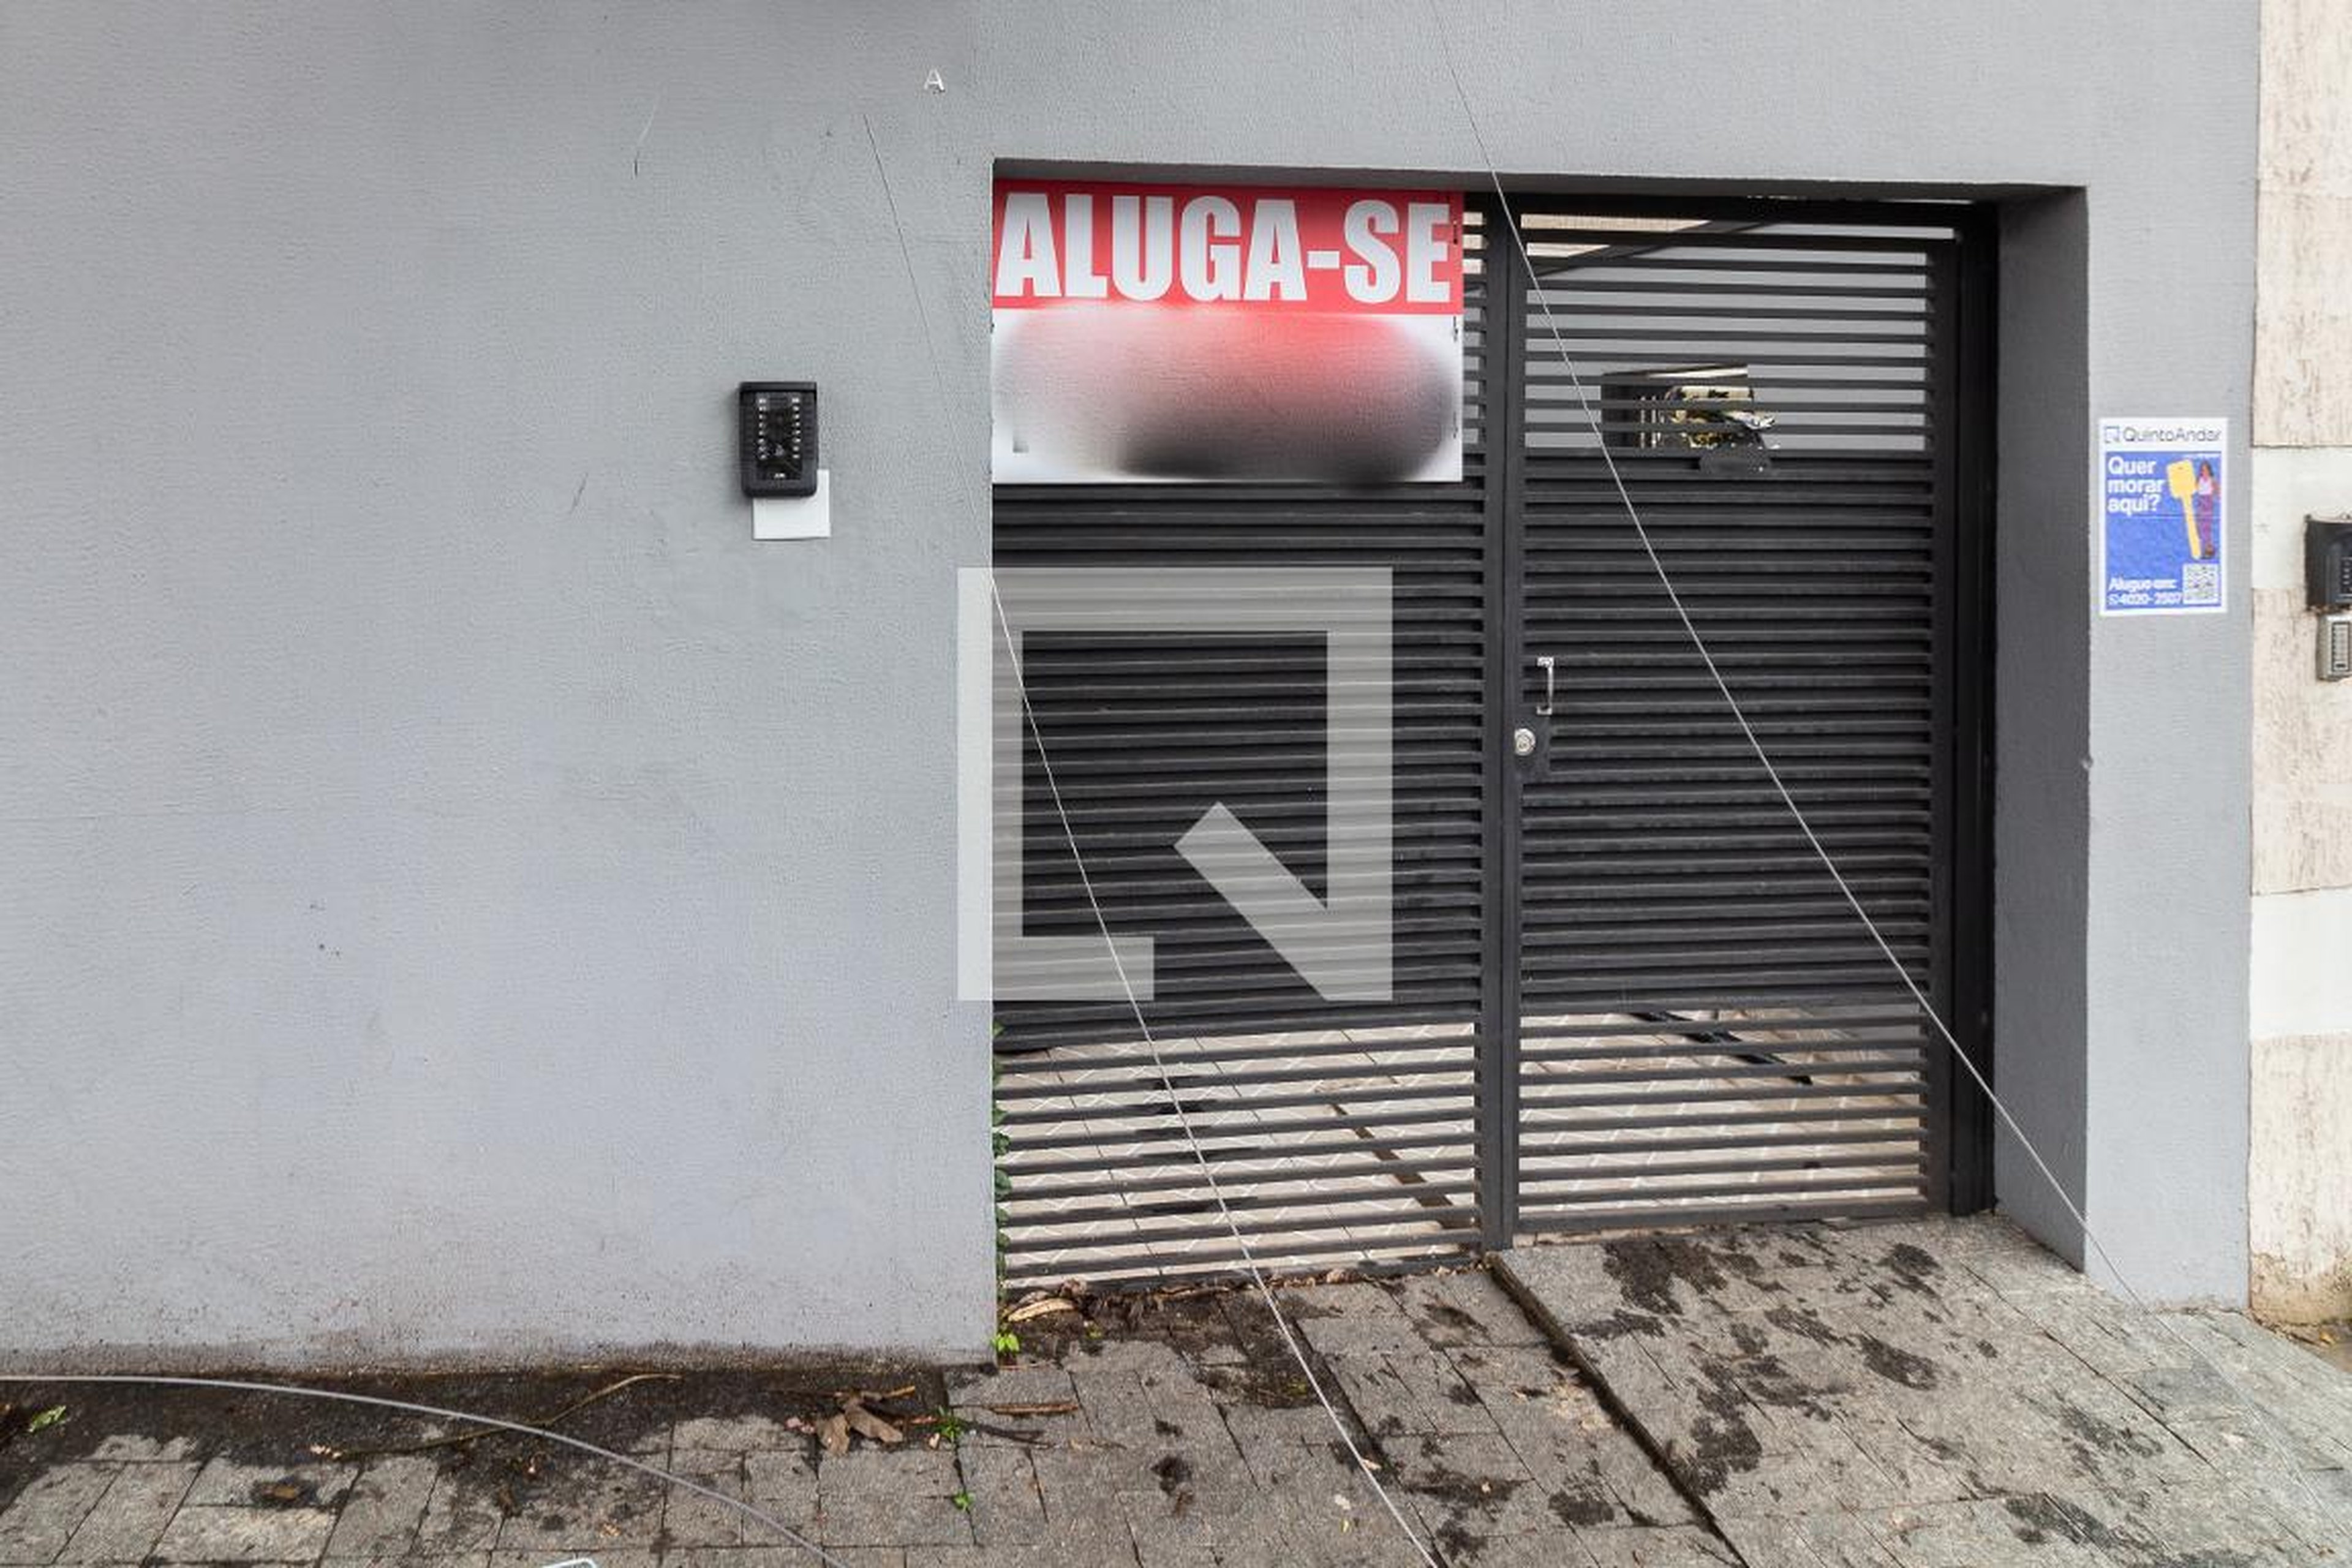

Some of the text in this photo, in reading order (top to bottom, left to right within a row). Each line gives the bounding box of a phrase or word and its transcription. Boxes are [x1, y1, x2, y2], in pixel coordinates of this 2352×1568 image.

[995, 193, 1450, 303] ALUGA-SE
[2124, 427, 2222, 442] QuintoAndar
[2108, 456, 2157, 475] Quer
[2107, 479, 2165, 493] morar
[2107, 494, 2160, 516] aqui?
